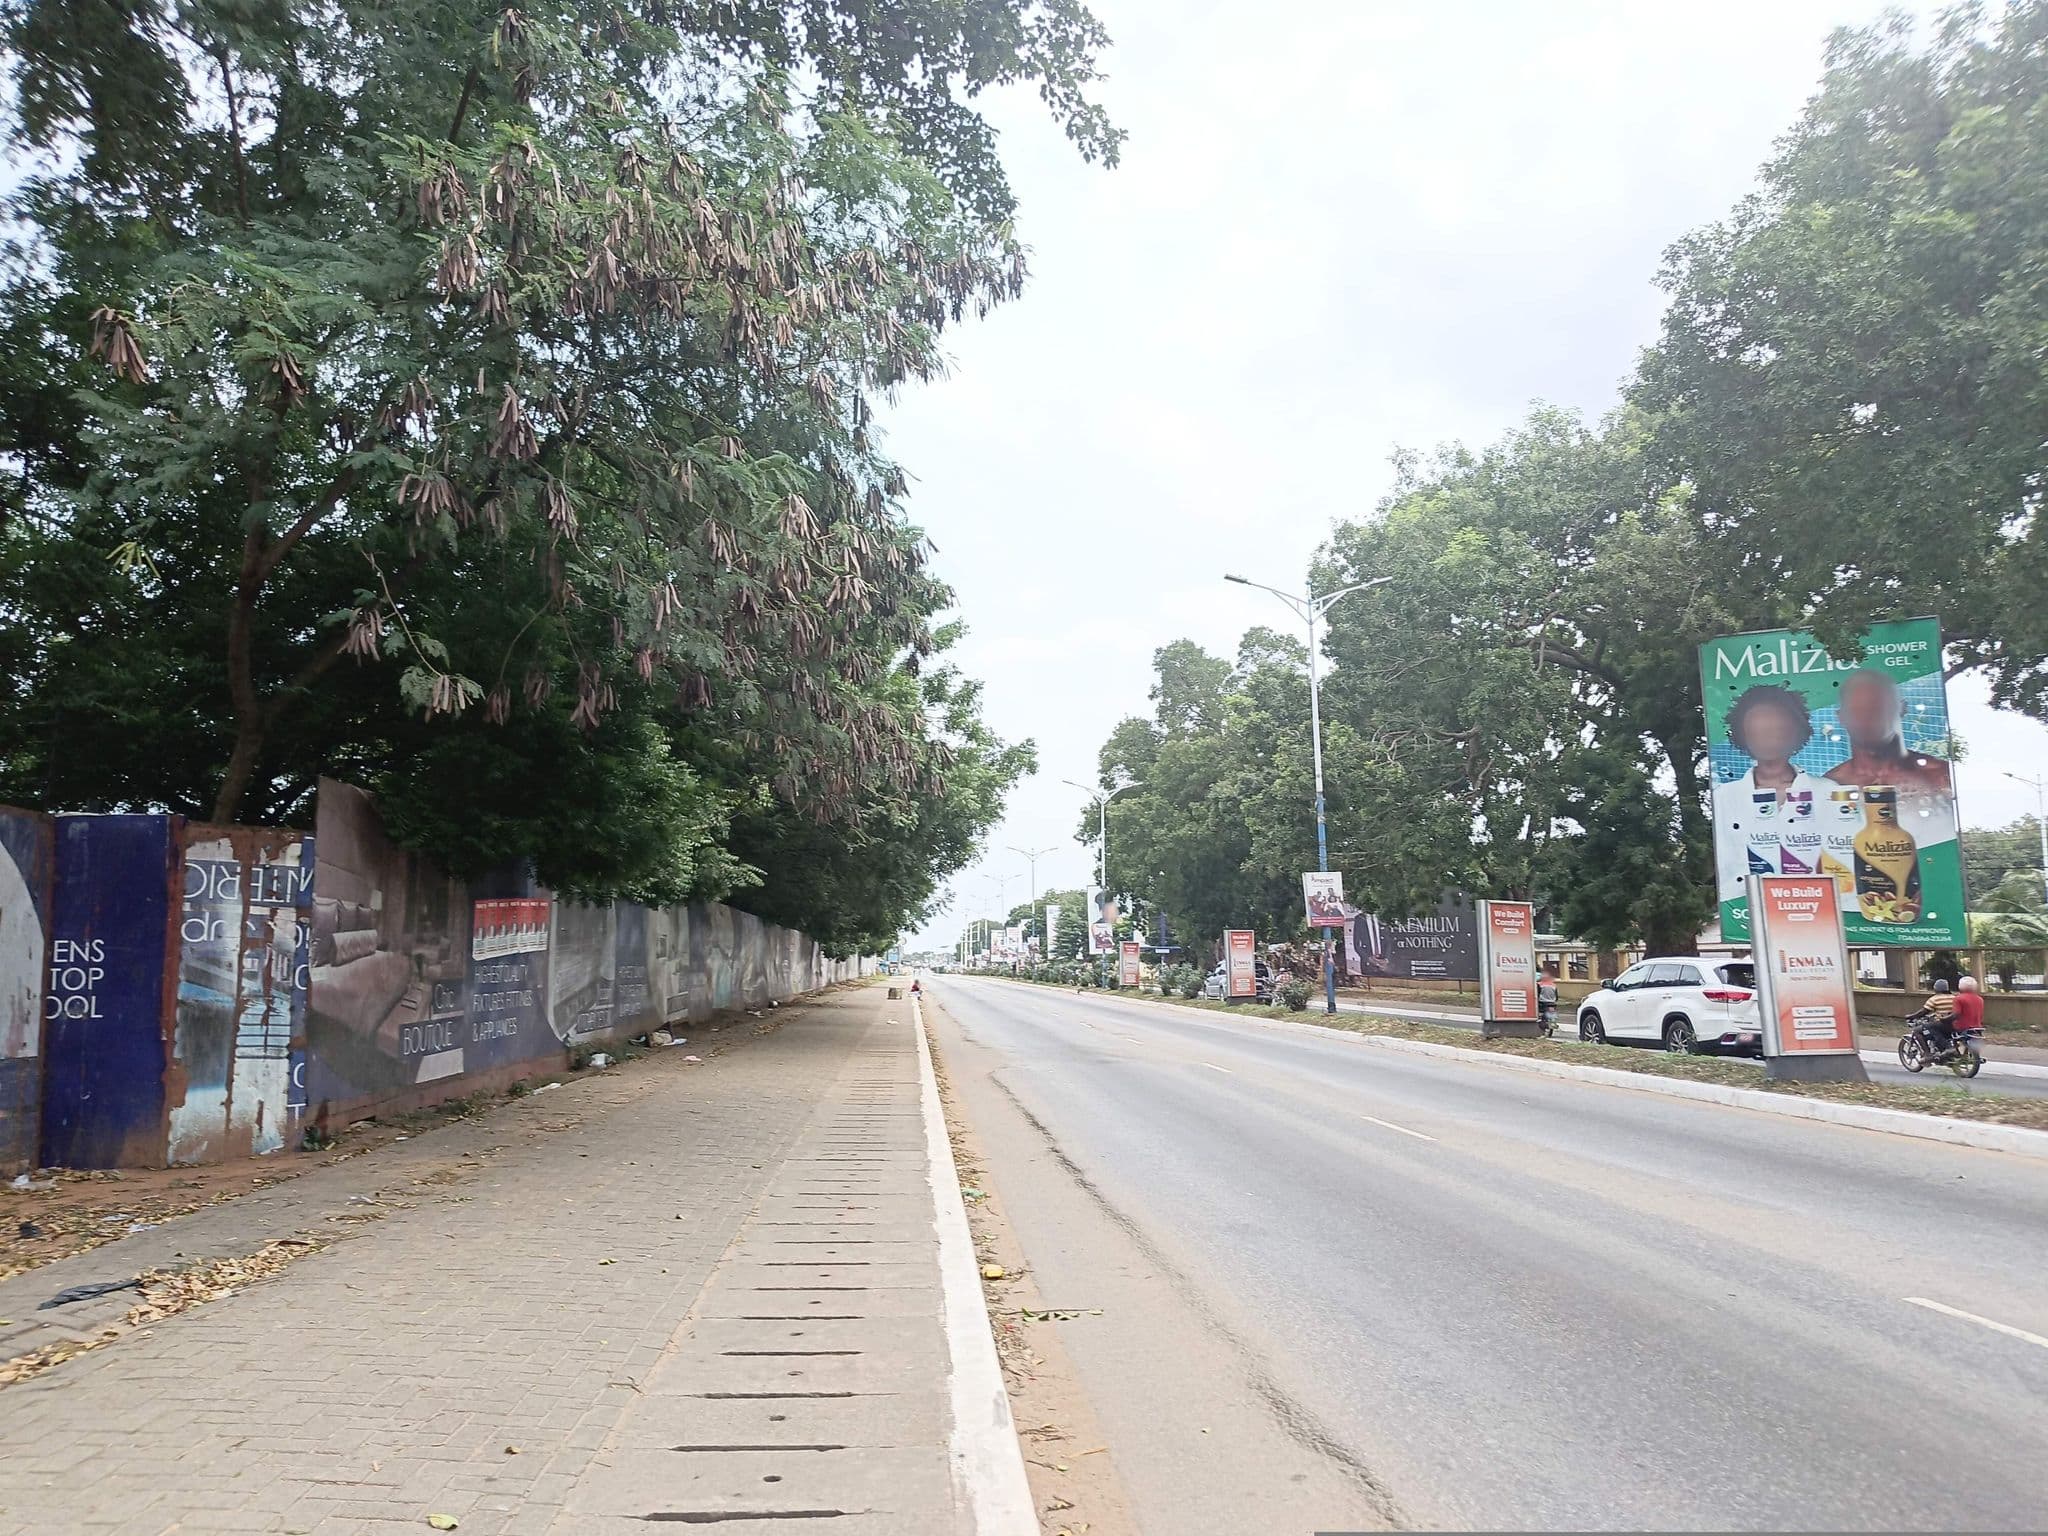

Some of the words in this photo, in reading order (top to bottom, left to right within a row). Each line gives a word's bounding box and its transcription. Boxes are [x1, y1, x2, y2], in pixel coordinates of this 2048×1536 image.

[1866, 641, 1928, 655] SHOWER
[1885, 655, 1912, 667] GEL
[1786, 833, 1822, 844] Malizia
[1865, 840, 1913, 854] Malizia
[1770, 887, 1791, 898] We
[1792, 886, 1823, 898] Build
[1777, 900, 1820, 913] Luxury
[1494, 910, 1506, 918] We
[1507, 910, 1525, 918] Build
[1494, 919, 1525, 927] Comfort
[1405, 936, 1453, 949] NOTHING
[53, 939, 105, 962] ENS
[49, 967, 104, 991] TOP
